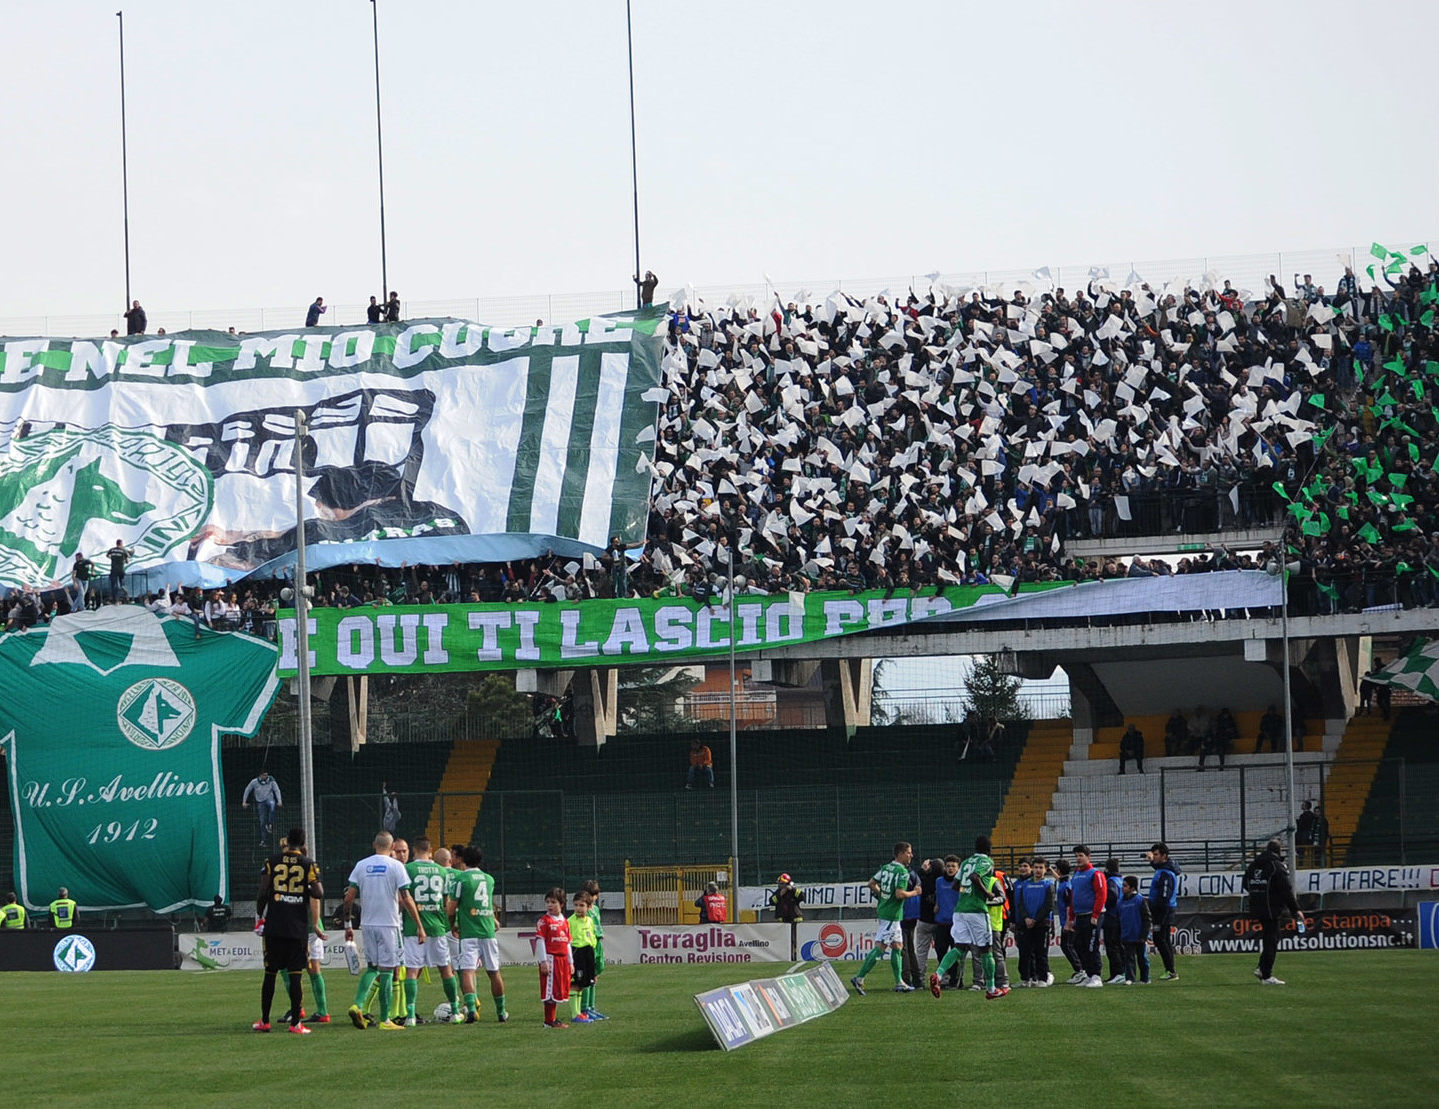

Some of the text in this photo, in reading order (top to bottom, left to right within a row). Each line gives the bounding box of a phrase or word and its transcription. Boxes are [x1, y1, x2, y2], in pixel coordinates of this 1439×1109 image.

[64, 337, 214, 382] NEL
[232, 330, 376, 372] MIO
[278, 617, 317, 670] E
[336, 613, 449, 670] QUI
[467, 610, 541, 661] TI
[560, 602, 807, 657] LASCIO
[87, 771, 211, 802] Avellino
[86, 817, 159, 845] 1912
[273, 863, 306, 893] 22
[414, 875, 444, 902] 29
[1309, 872, 1320, 892] A
[1328, 868, 1421, 891] TIFARE!!!
[474, 881, 489, 907] 4
[638, 927, 770, 952] Terraglia Avellino
[639, 952, 751, 964] Centro Revisione
